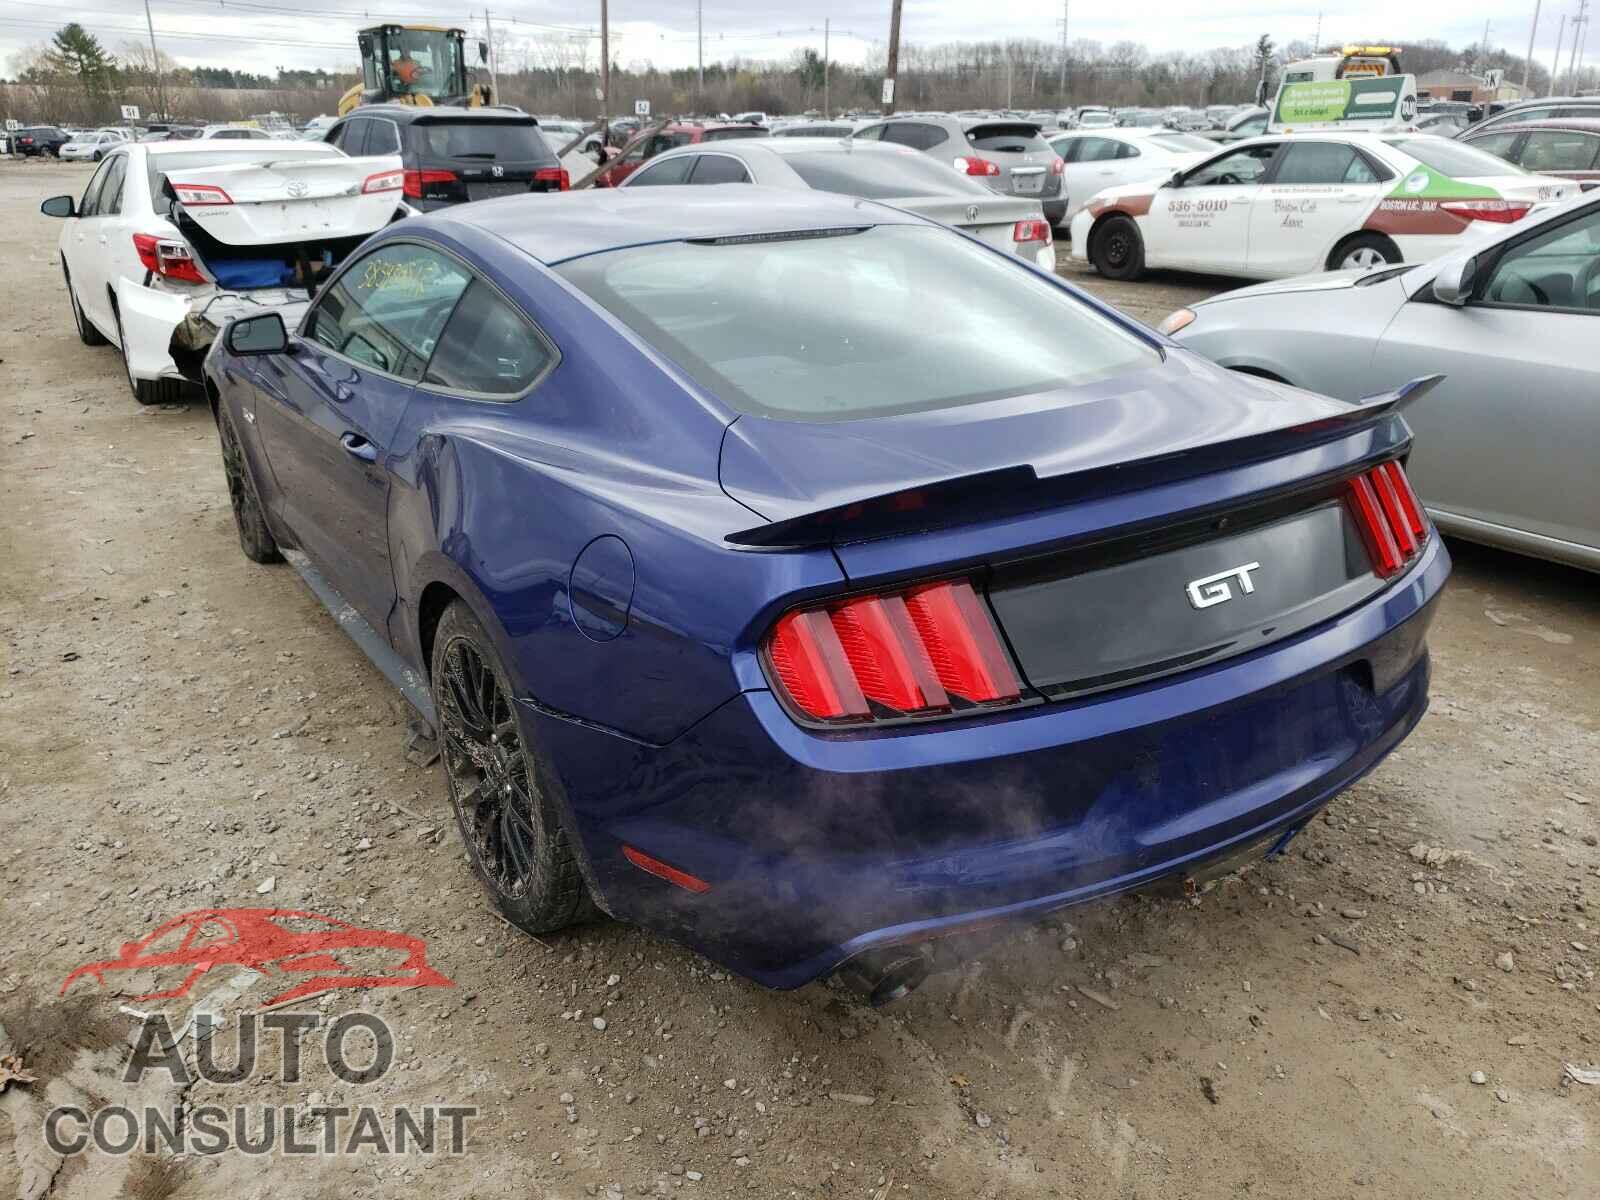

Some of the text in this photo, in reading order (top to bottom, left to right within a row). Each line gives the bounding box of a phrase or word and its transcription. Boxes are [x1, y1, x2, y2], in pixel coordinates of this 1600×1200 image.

[1168, 199, 1228, 212] 536-5010
[1379, 199, 1408, 211] BOSTON
[1185, 561, 1260, 609] GT
